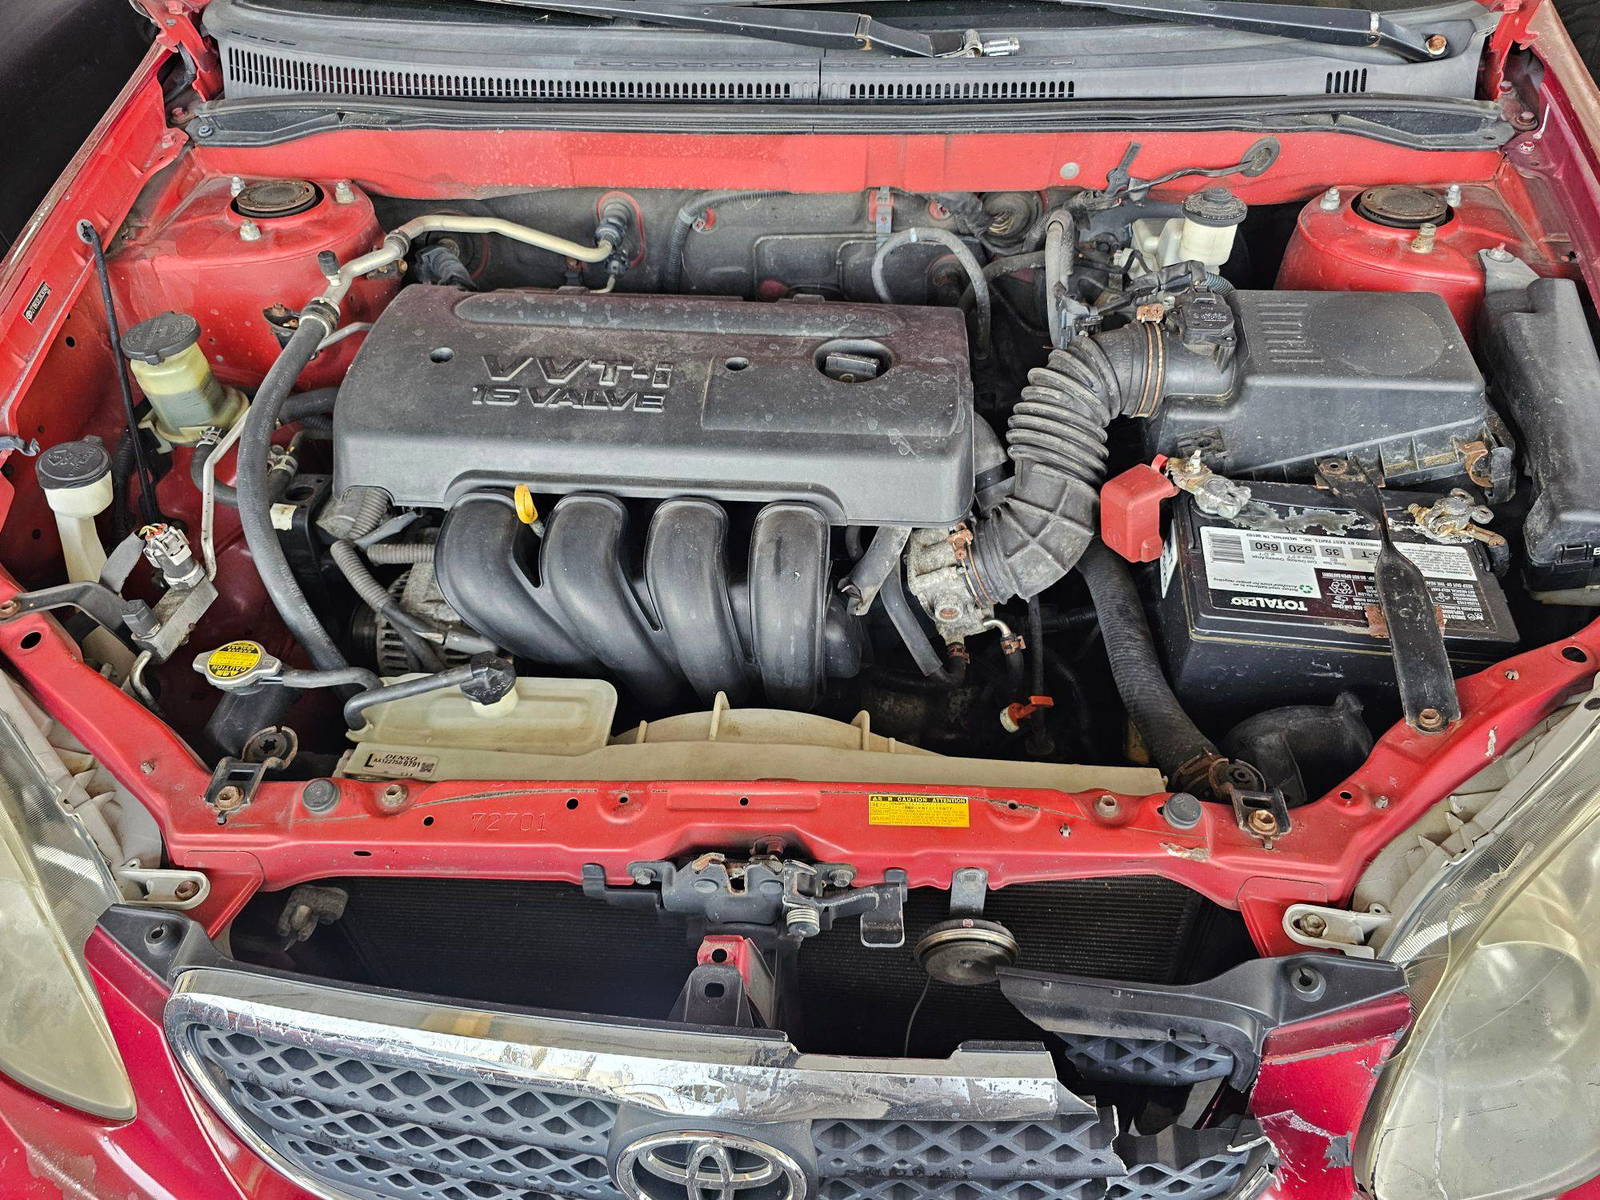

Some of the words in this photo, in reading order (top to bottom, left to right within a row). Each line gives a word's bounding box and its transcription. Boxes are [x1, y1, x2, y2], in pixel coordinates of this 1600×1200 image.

[1255, 541, 1279, 552] 650
[1289, 544, 1313, 554] 520
[1325, 548, 1340, 556] 35
[1231, 597, 1308, 612] TOTALPRO
